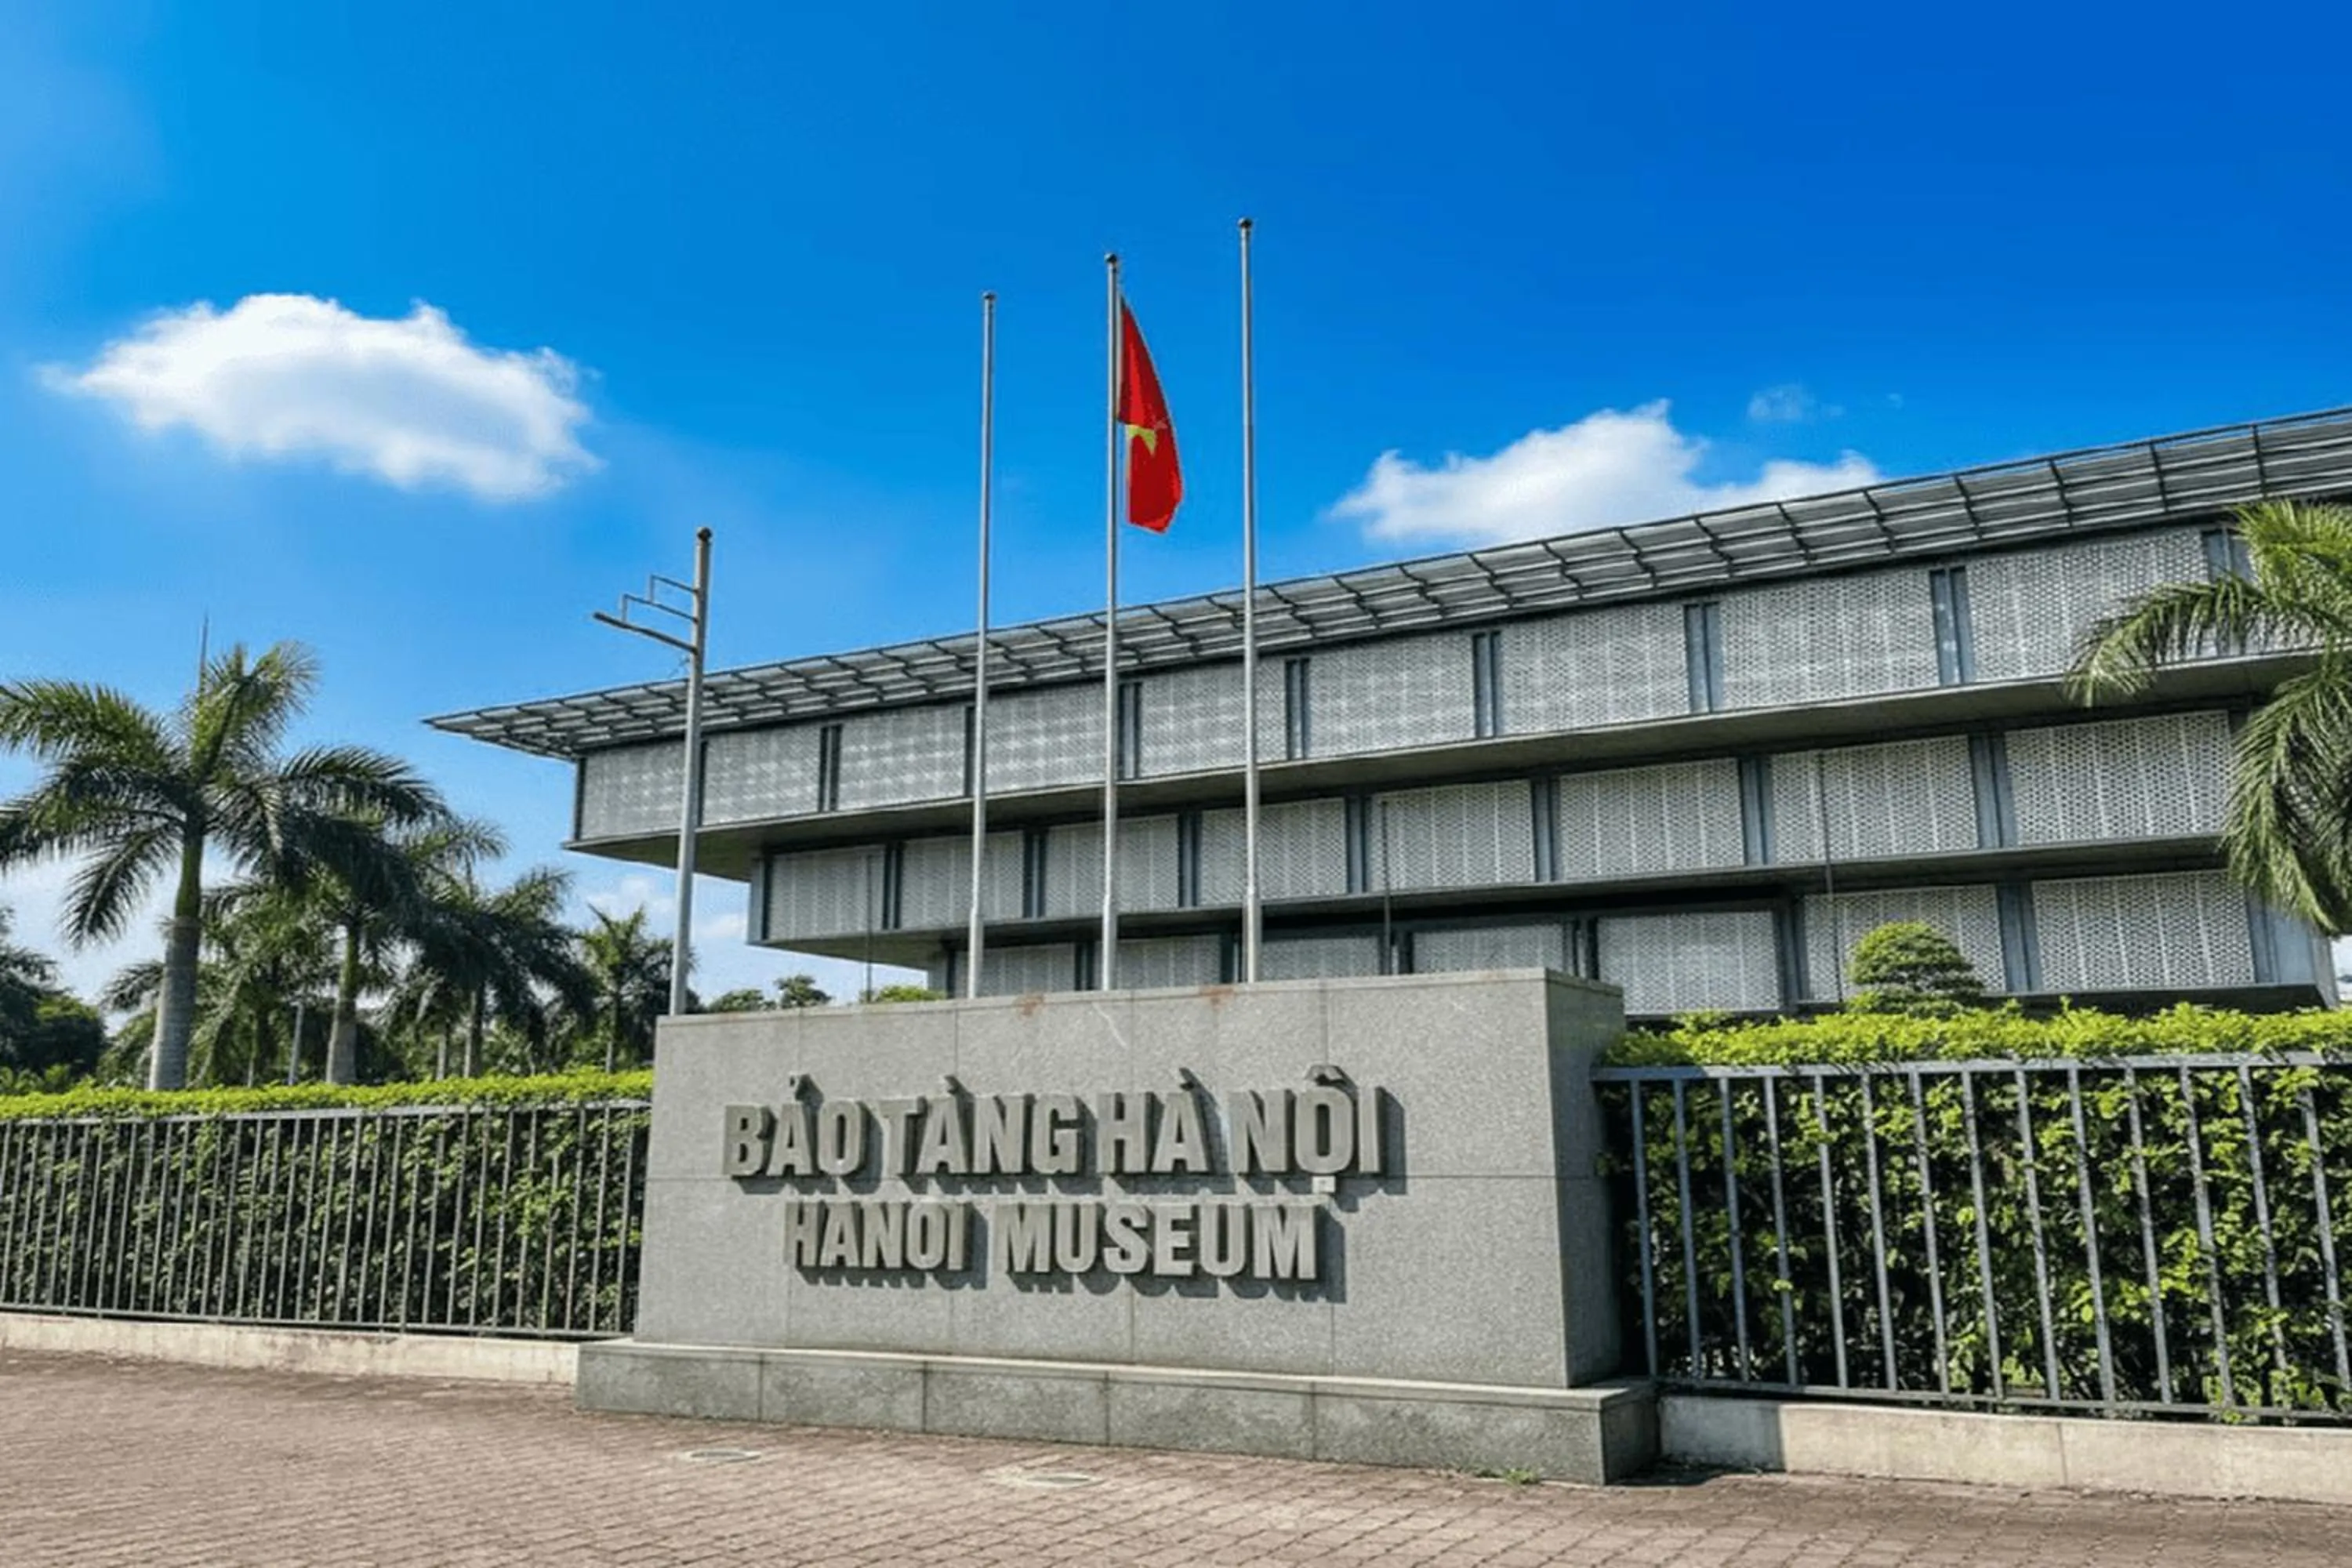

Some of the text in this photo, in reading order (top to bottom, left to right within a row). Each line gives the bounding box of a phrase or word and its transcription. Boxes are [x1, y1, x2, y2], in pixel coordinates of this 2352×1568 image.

[723, 1064, 1381, 1194] BẢO TÀNG HÀ NỘI
[785, 1200, 1317, 1279] HANOI MUSEUM
